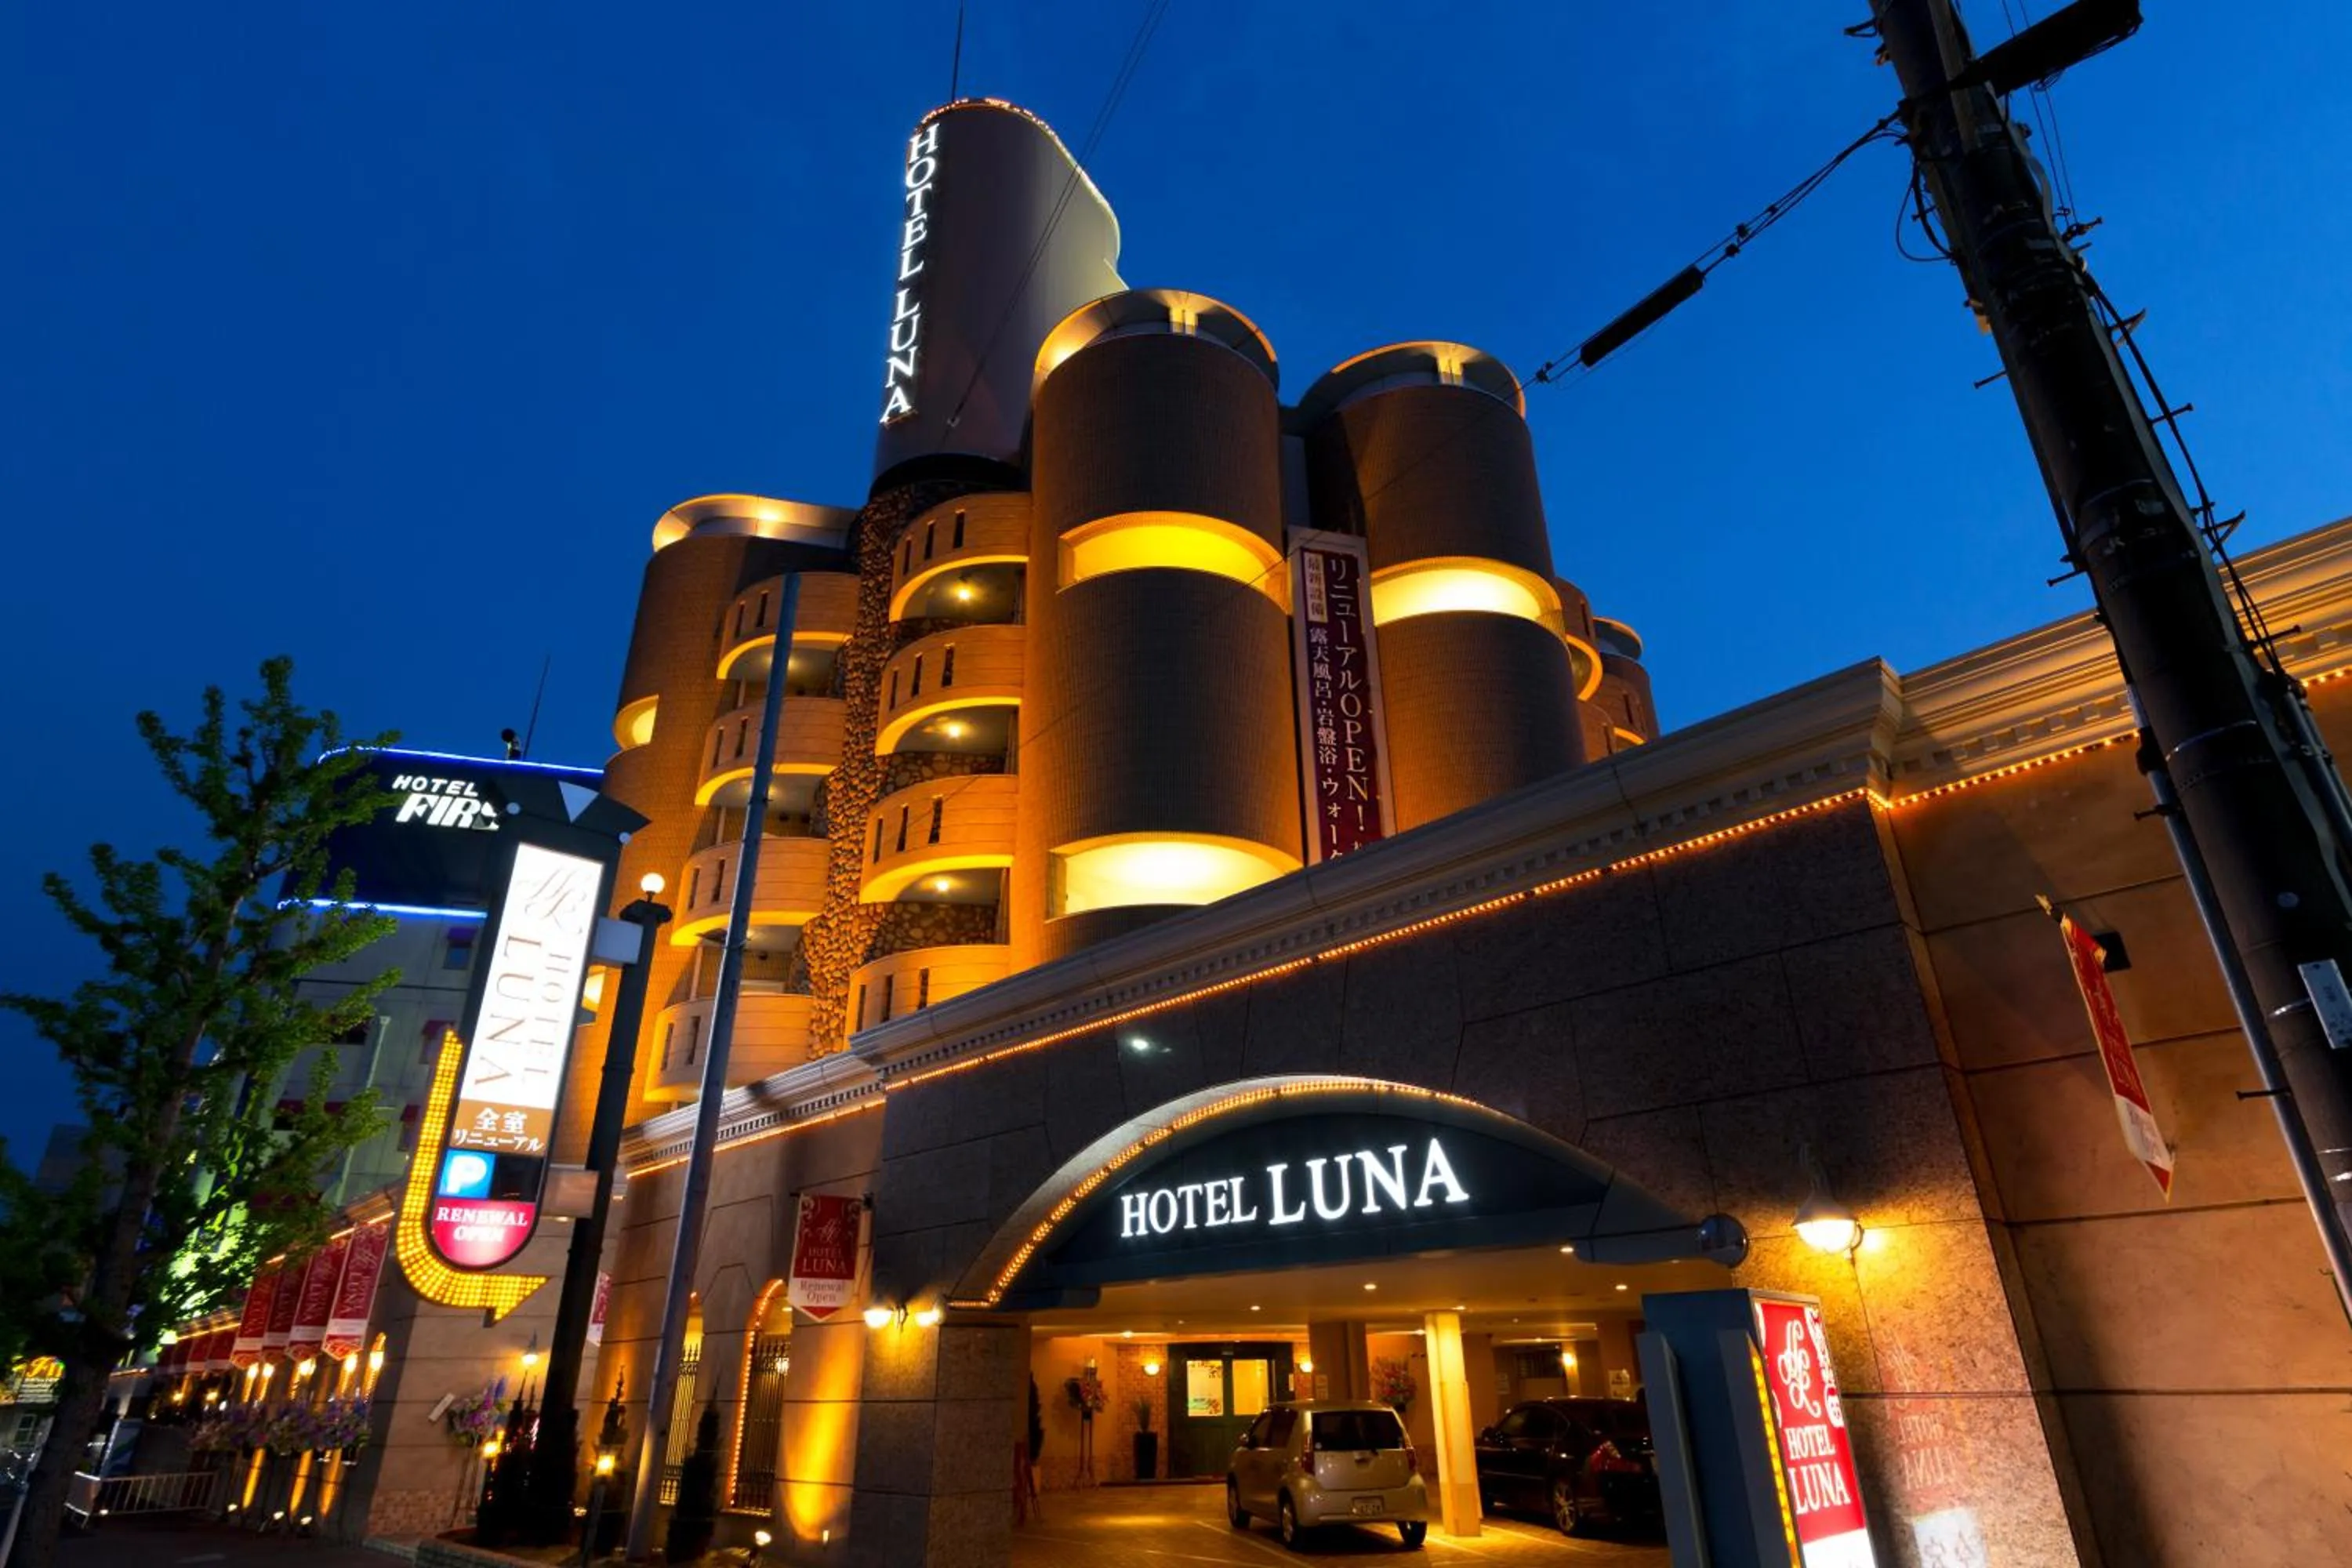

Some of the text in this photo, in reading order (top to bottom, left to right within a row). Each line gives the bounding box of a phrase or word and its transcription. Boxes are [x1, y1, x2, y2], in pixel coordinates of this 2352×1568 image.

[879, 122, 940, 423] HOTEL LUNA
[392, 775, 478, 797] HOTEL
[474, 935, 542, 1085] LUNA
[474, 1107, 528, 1134] 全室
[454, 1128, 545, 1152] リニューアル
[1121, 1138, 1469, 1238] HOTEL LUNA
[437, 1207, 528, 1227] RENEWAL
[453, 1225, 507, 1243] OPEN
[802, 1258, 848, 1274] LUNA
[800, 1280, 844, 1292] Renewal
[807, 1291, 837, 1304] Open
[1784, 1425, 1835, 1461] HOTEL
[1788, 1462, 1851, 1515] LUNA
